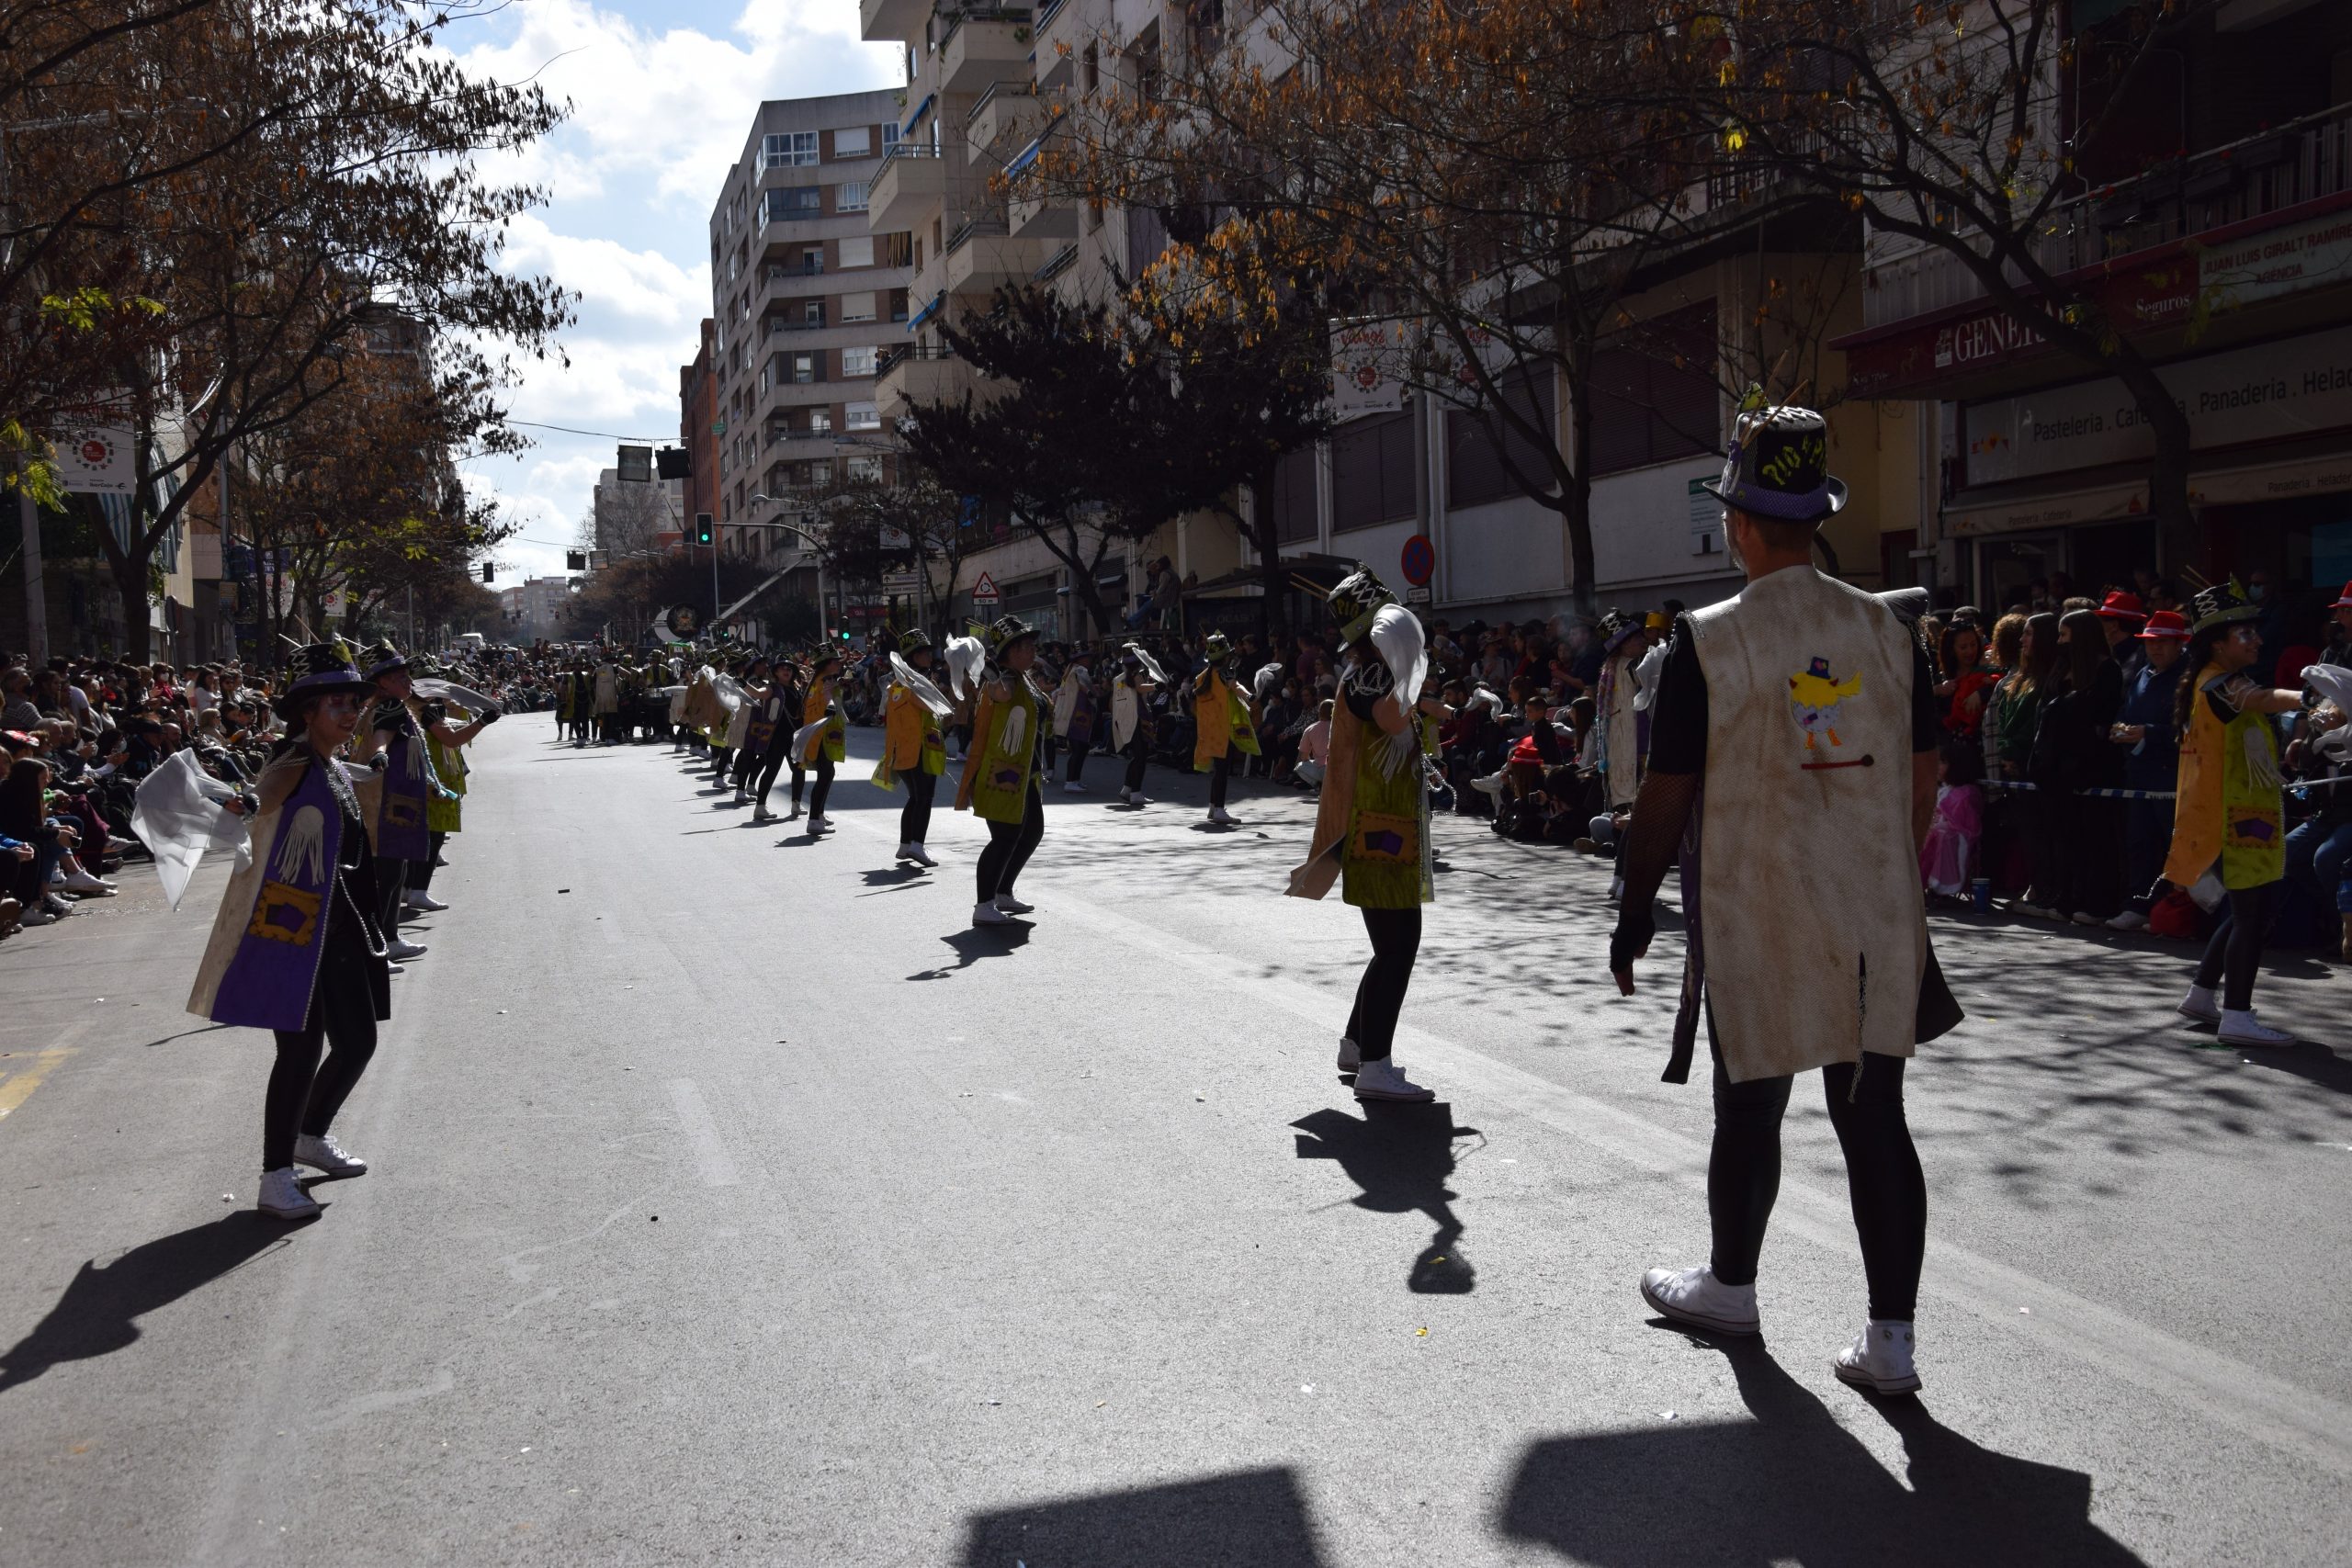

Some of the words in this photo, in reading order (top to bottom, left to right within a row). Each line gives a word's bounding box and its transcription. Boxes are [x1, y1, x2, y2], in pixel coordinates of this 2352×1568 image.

[2205, 258, 2233, 274] JUAN
[2235, 249, 2261, 265] LUIS
[2264, 237, 2305, 259] GIRALT
[2136, 294, 2191, 320] Seguros
[2199, 378, 2287, 413] Panaderia
